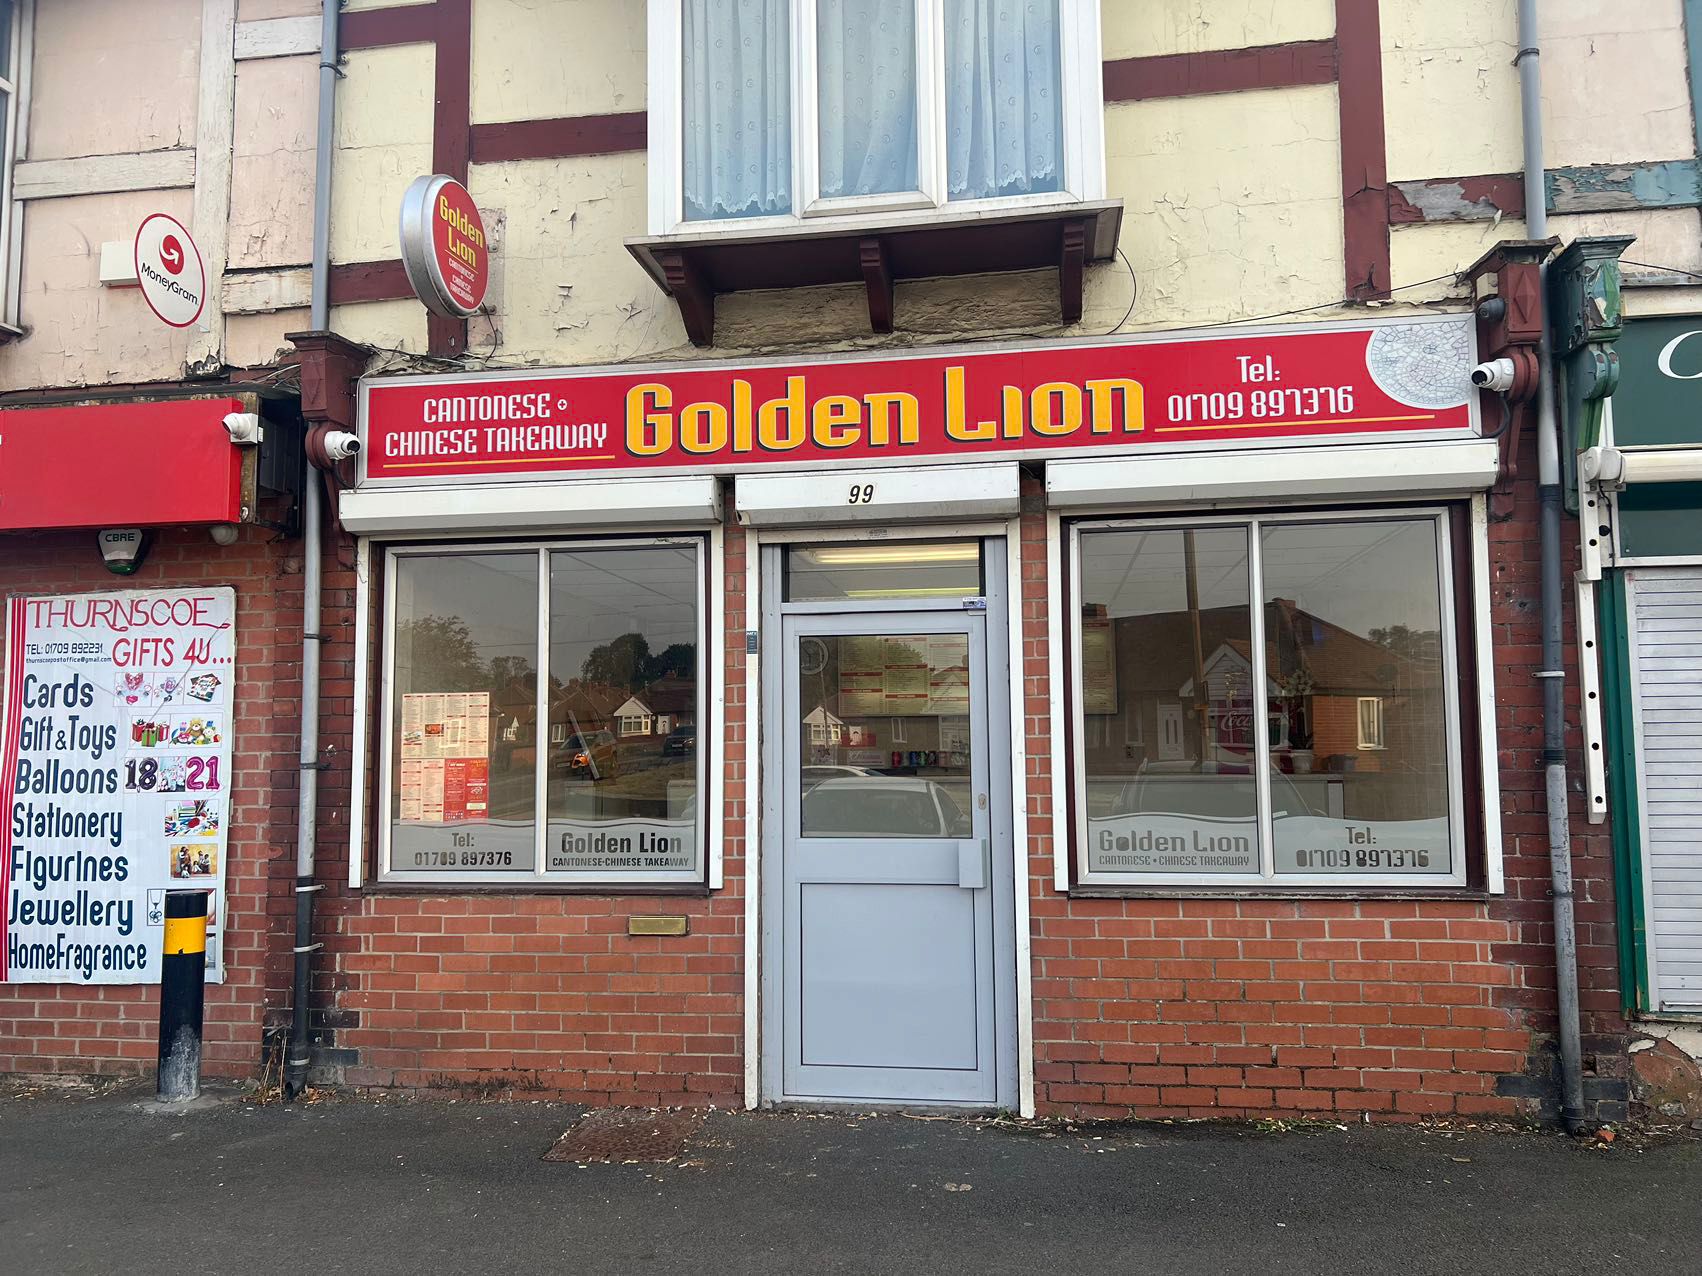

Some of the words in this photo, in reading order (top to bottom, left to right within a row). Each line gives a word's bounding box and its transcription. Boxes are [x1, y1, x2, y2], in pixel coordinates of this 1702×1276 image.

[439, 195, 484, 249] Golden
[448, 226, 477, 268] Lion
[1236, 354, 1281, 383] Tel:
[423, 392, 550, 423] CANTONESE
[625, 376, 921, 458] Golden
[944, 365, 1145, 442] Lion
[1167, 391, 1244, 423] 01709
[1251, 385, 1354, 419] 897376
[384, 428, 477, 458] CHINESE
[483, 422, 608, 454] TAKEAWAY
[849, 484, 874, 505] 99
[28, 597, 231, 632] THURNSCOE
[26, 643, 43, 655] TEL:
[45, 643, 69, 654] 01709
[71, 642, 103, 654] 892231
[112, 637, 175, 667] GIFTS
[23, 673, 94, 709] Cards
[15, 758, 118, 795] Balloons
[124, 757, 158, 792] 18
[186, 755, 221, 791] 21
[12, 801, 123, 847] Stationery
[452, 832, 475, 847] Tel:
[1099, 829, 1186, 852] Golden
[1193, 830, 1249, 853] Lion
[1345, 826, 1377, 845] Tel:
[414, 852, 457, 866] 01709
[461, 851, 512, 866] 897376
[561, 832, 632, 854] Golden
[639, 832, 682, 854] Lion
[1099, 855, 1151, 866] CANTONESE
[1158, 855, 1197, 866] CHINESE
[1199, 855, 1250, 866] TAKEAWAY
[1296, 849, 1350, 868] 01709
[1355, 849, 1429, 868] 897376
[10, 846, 129, 890] Figurines
[644, 857, 689, 867] TAKEAWAY
[8, 889, 134, 936] Jewellery
[8, 932, 147, 981] HomeFragrance
